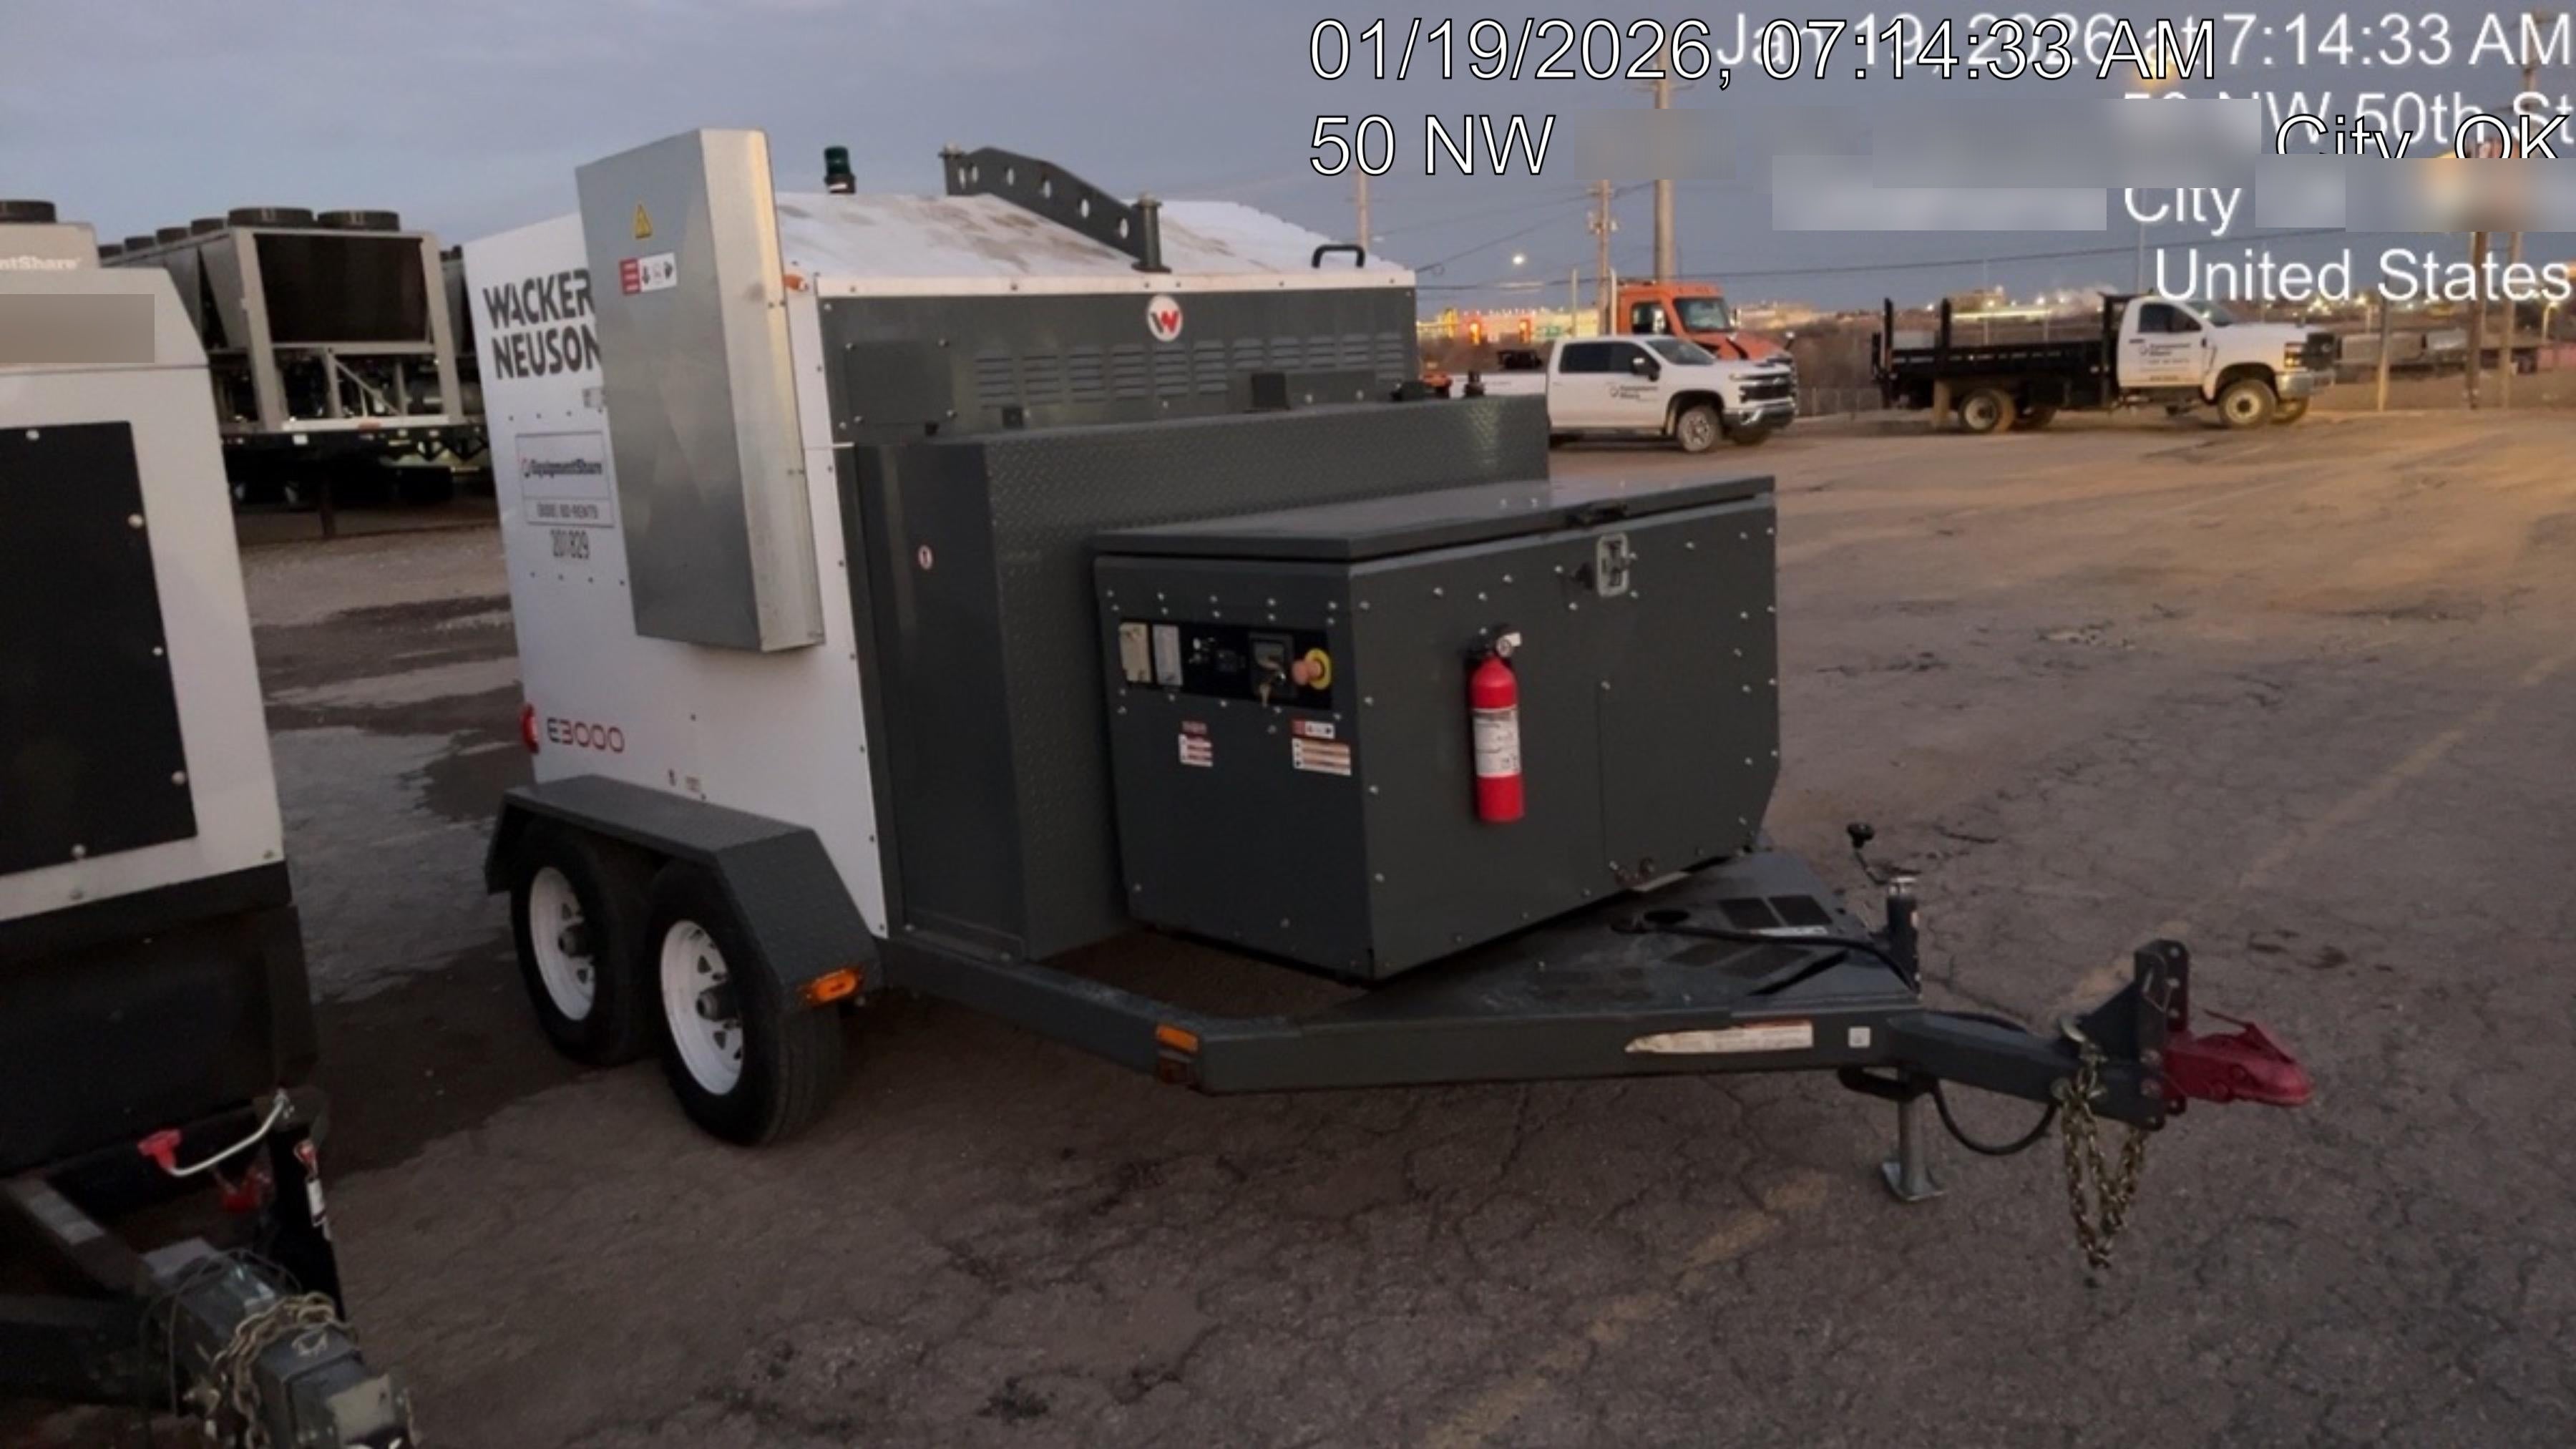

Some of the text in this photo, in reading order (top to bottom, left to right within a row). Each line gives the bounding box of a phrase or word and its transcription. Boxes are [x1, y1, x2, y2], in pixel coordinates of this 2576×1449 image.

[482, 268, 596, 330] WACKER
[491, 324, 602, 380] NEUSON
[546, 716, 626, 754] E3000
